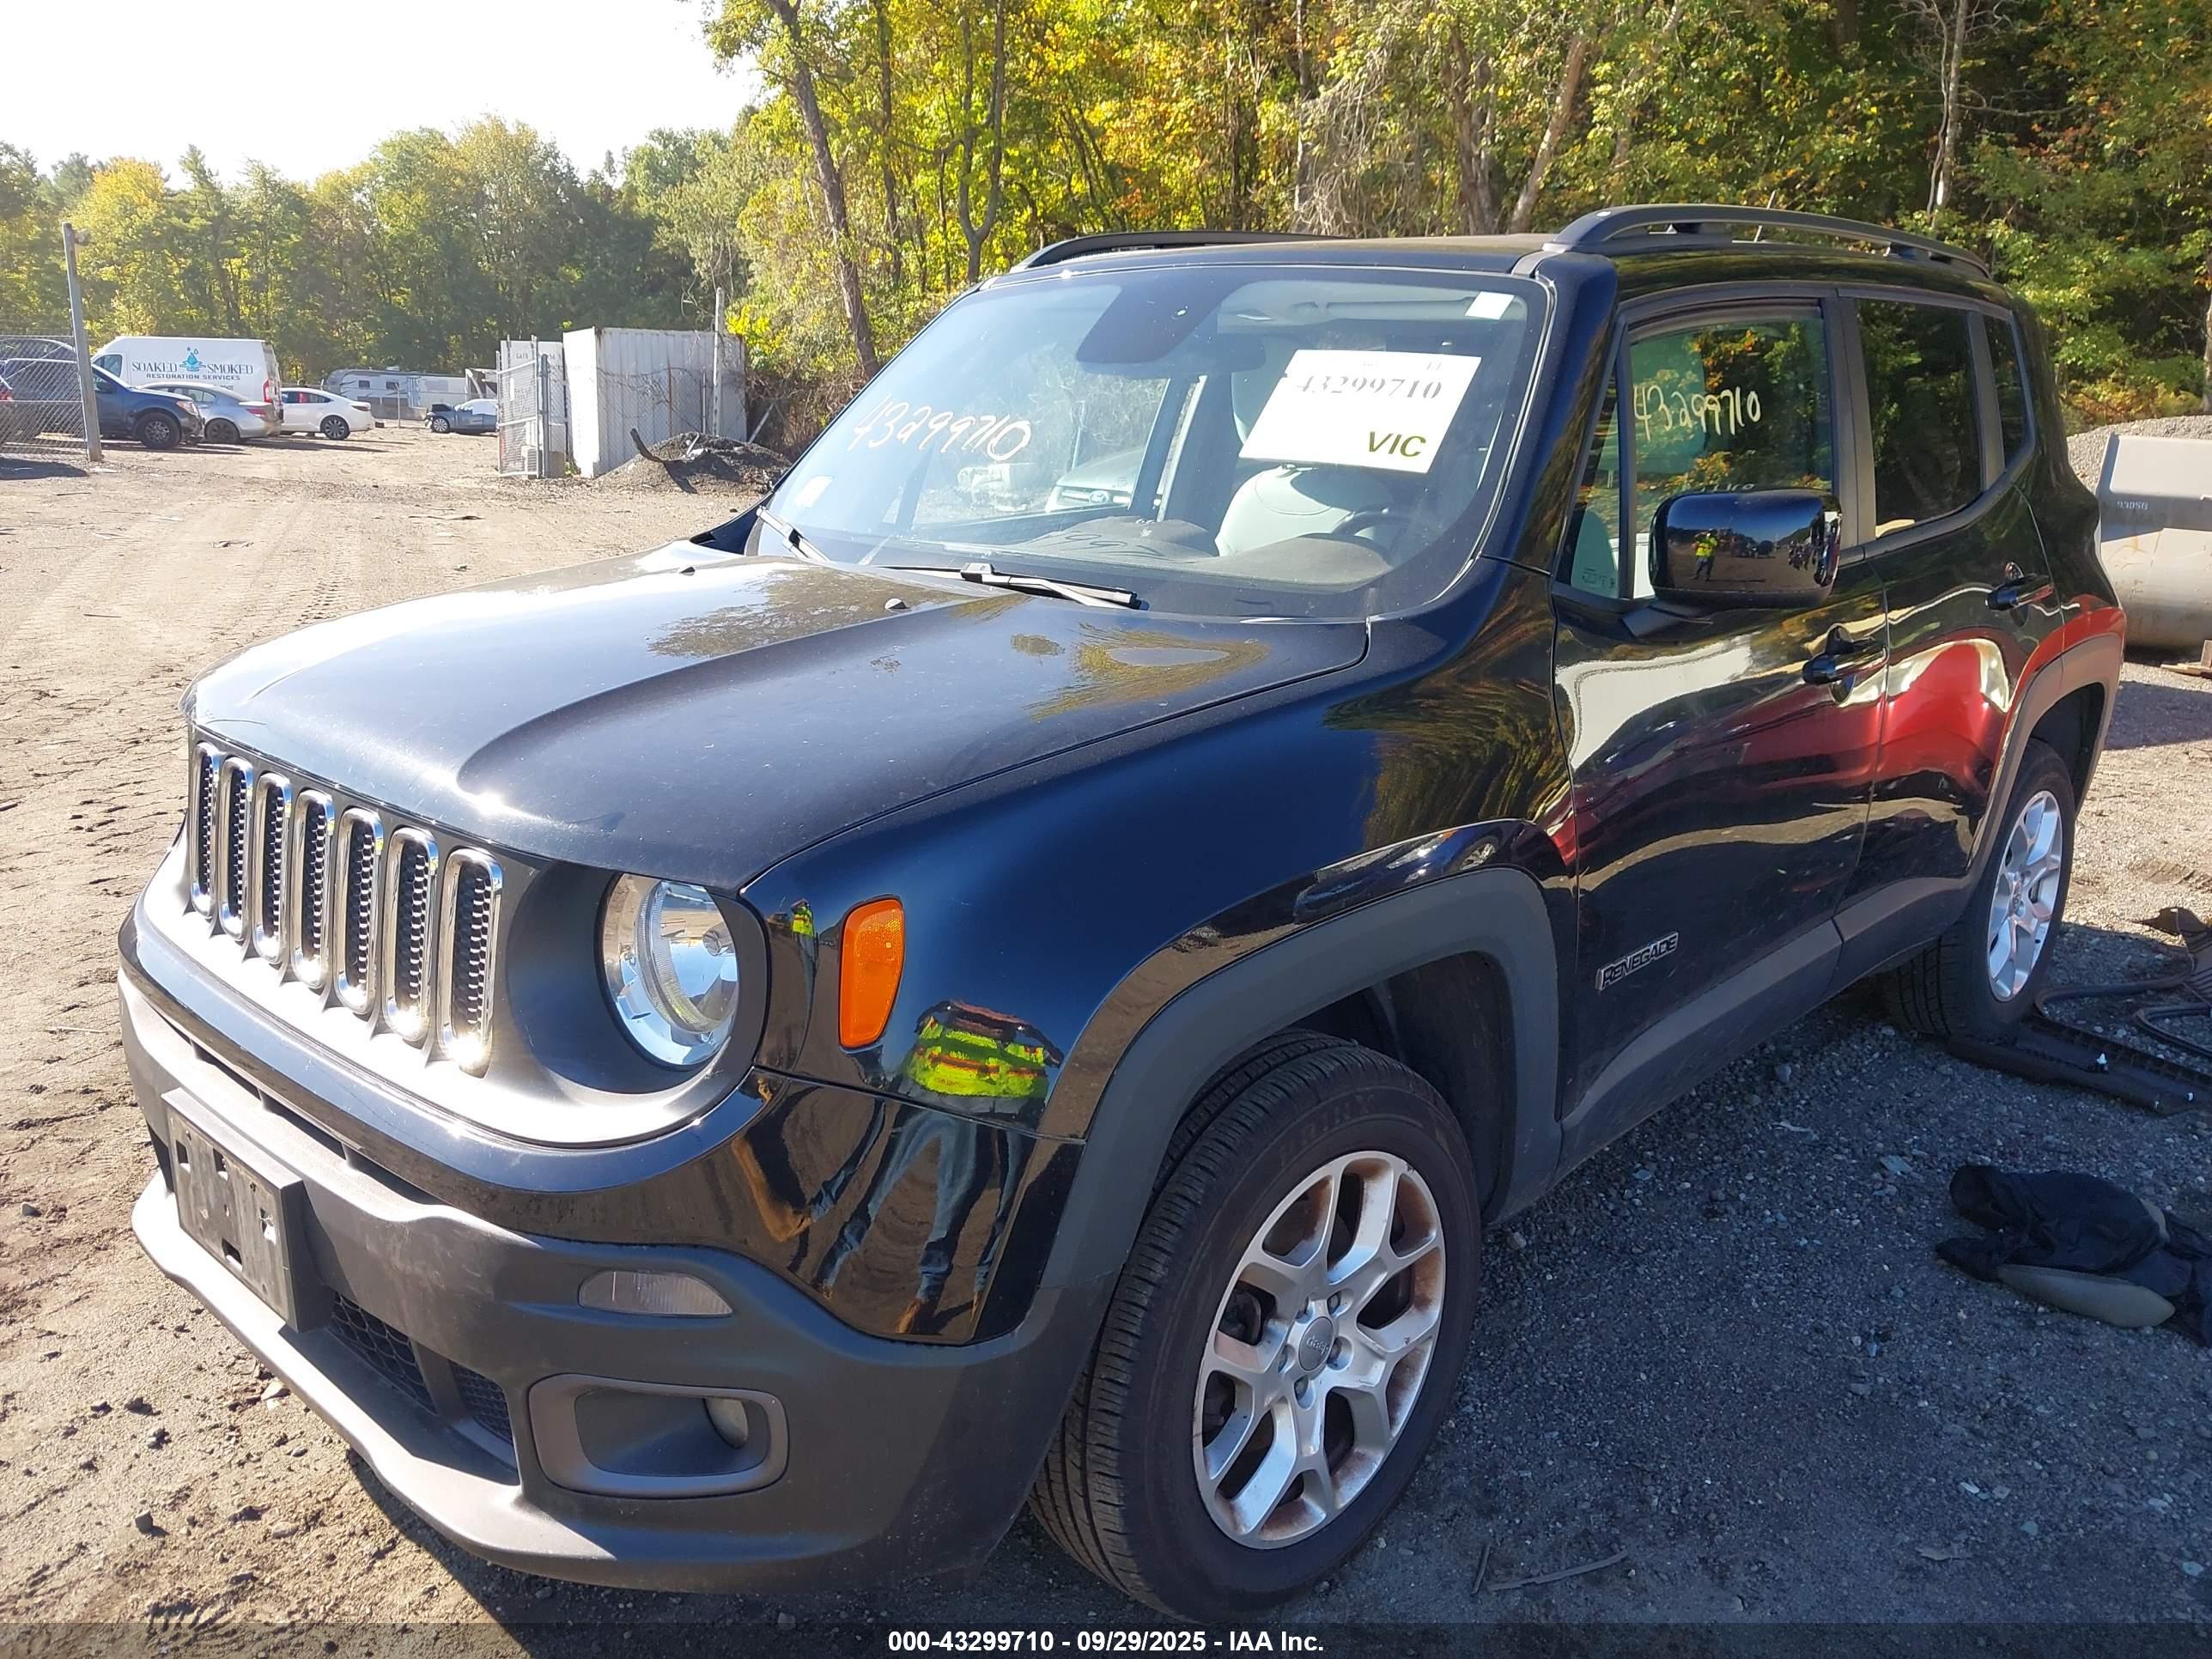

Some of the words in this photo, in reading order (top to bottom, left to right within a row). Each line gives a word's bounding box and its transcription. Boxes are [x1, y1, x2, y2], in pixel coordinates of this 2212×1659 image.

[131, 362, 177, 373] SOAKED
[207, 364, 253, 374] SMOKED
[1297, 375, 1442, 399] 43299710
[847, 393, 1031, 461] 43299710
[1633, 385, 1761, 442] 43299710
[1369, 431, 1426, 457] VIC
[1600, 933, 1679, 989] RENEGADE
